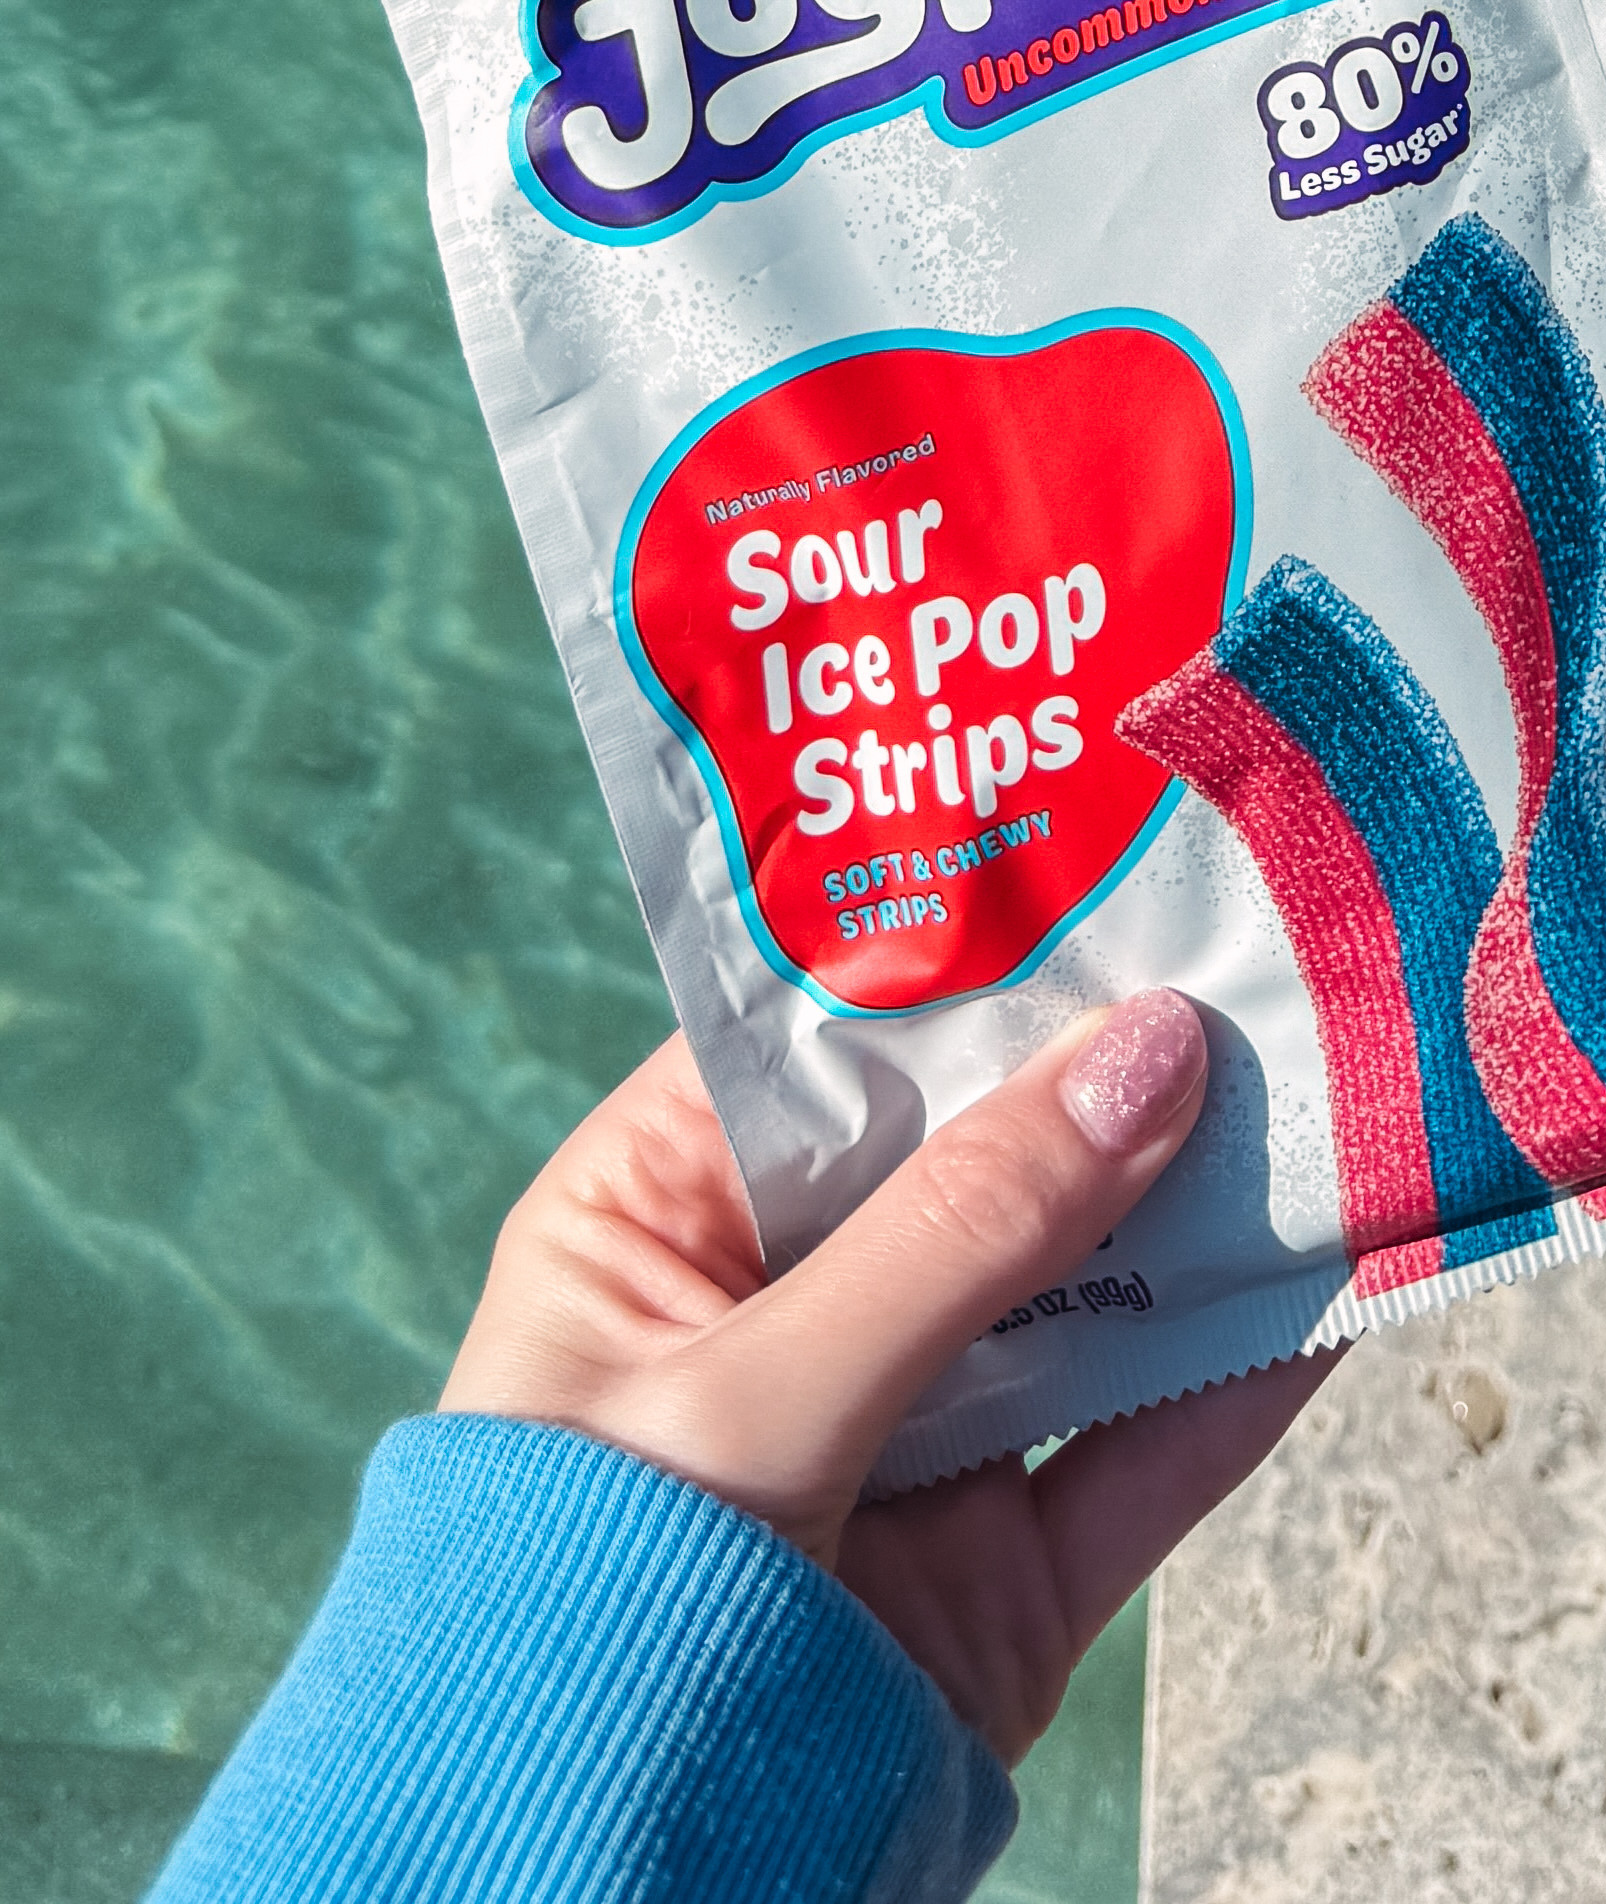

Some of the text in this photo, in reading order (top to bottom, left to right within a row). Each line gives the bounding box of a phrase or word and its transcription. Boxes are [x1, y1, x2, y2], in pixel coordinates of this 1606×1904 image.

[1266, 21, 1461, 160] 80%
[1278, 157, 1361, 202] Less
[705, 433, 938, 526] Naturally Flavored
[725, 499, 945, 632] Sour
[760, 562, 1107, 735] Ice Pop
[791, 694, 1084, 837] Strips
[823, 809, 1054, 904] SOFT & CHEWY
[838, 891, 949, 941] STRIPS
[1033, 1287, 1078, 1317] OZ
[1078, 1270, 1154, 1314] (99g)
